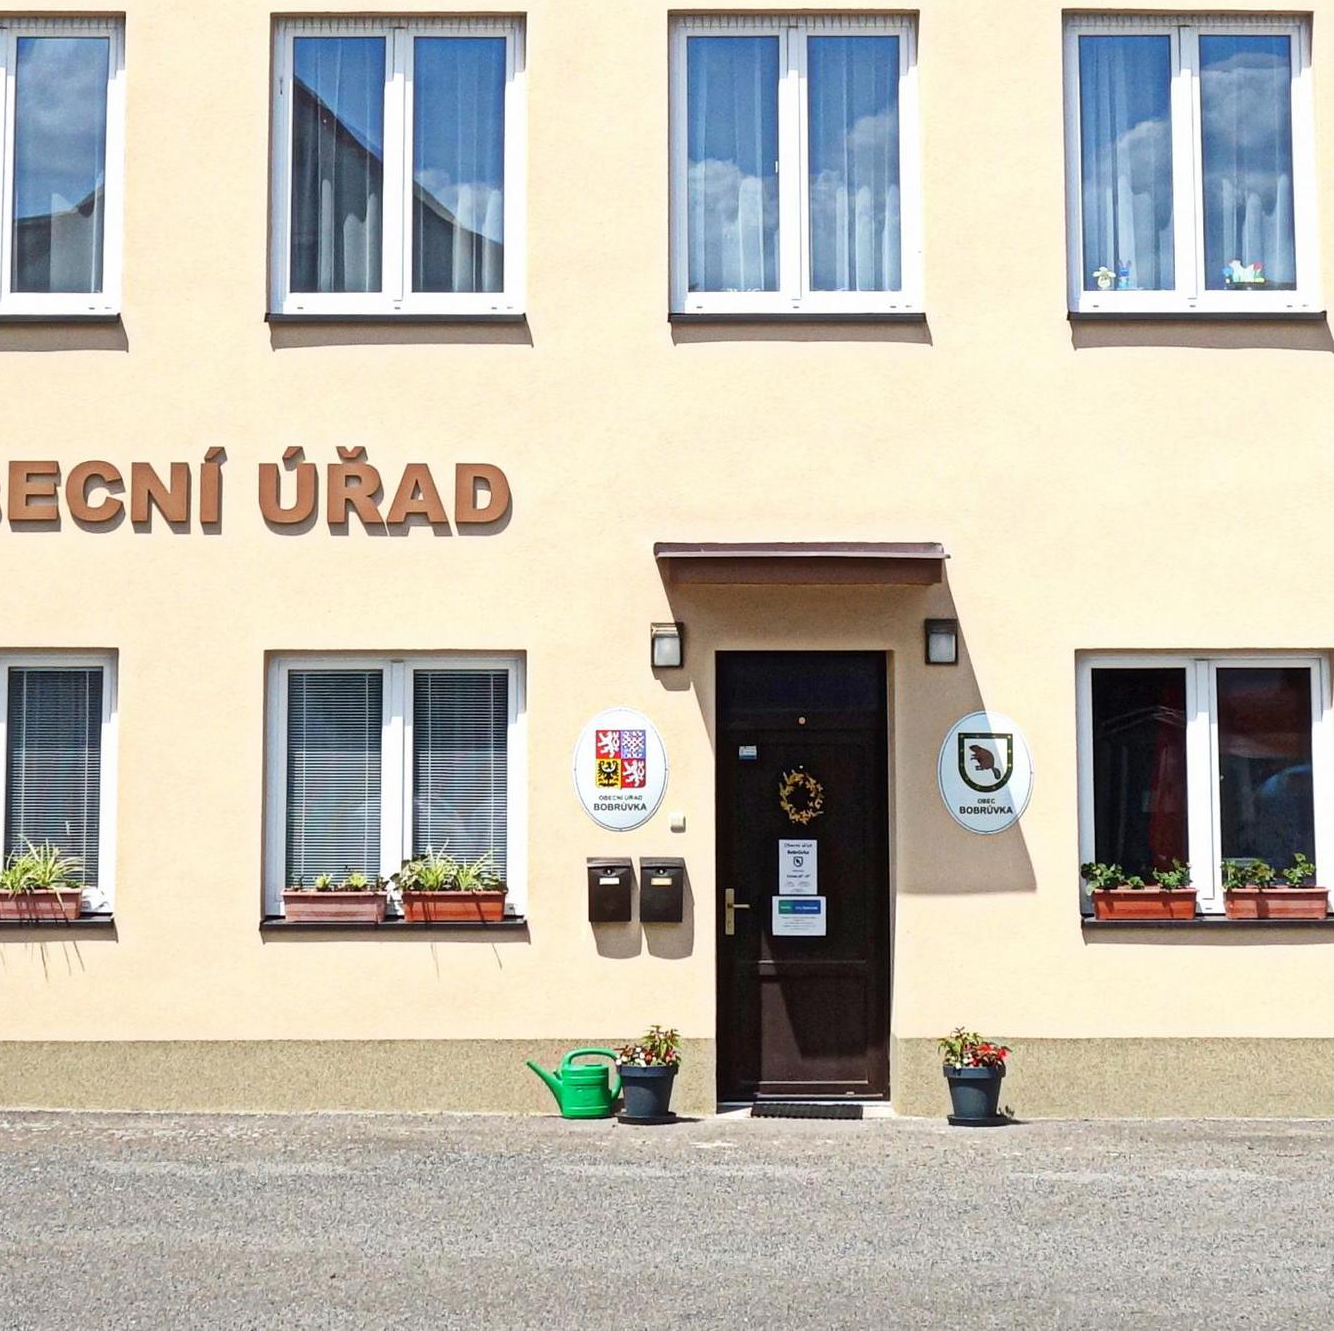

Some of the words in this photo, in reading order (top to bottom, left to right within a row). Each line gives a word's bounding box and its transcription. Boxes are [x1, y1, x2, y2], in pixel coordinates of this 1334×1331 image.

[258, 446, 511, 534] ÚŘAD
[593, 801, 647, 811] BOBRŮVKA
[959, 804, 1013, 814] BOBRŮVKA
